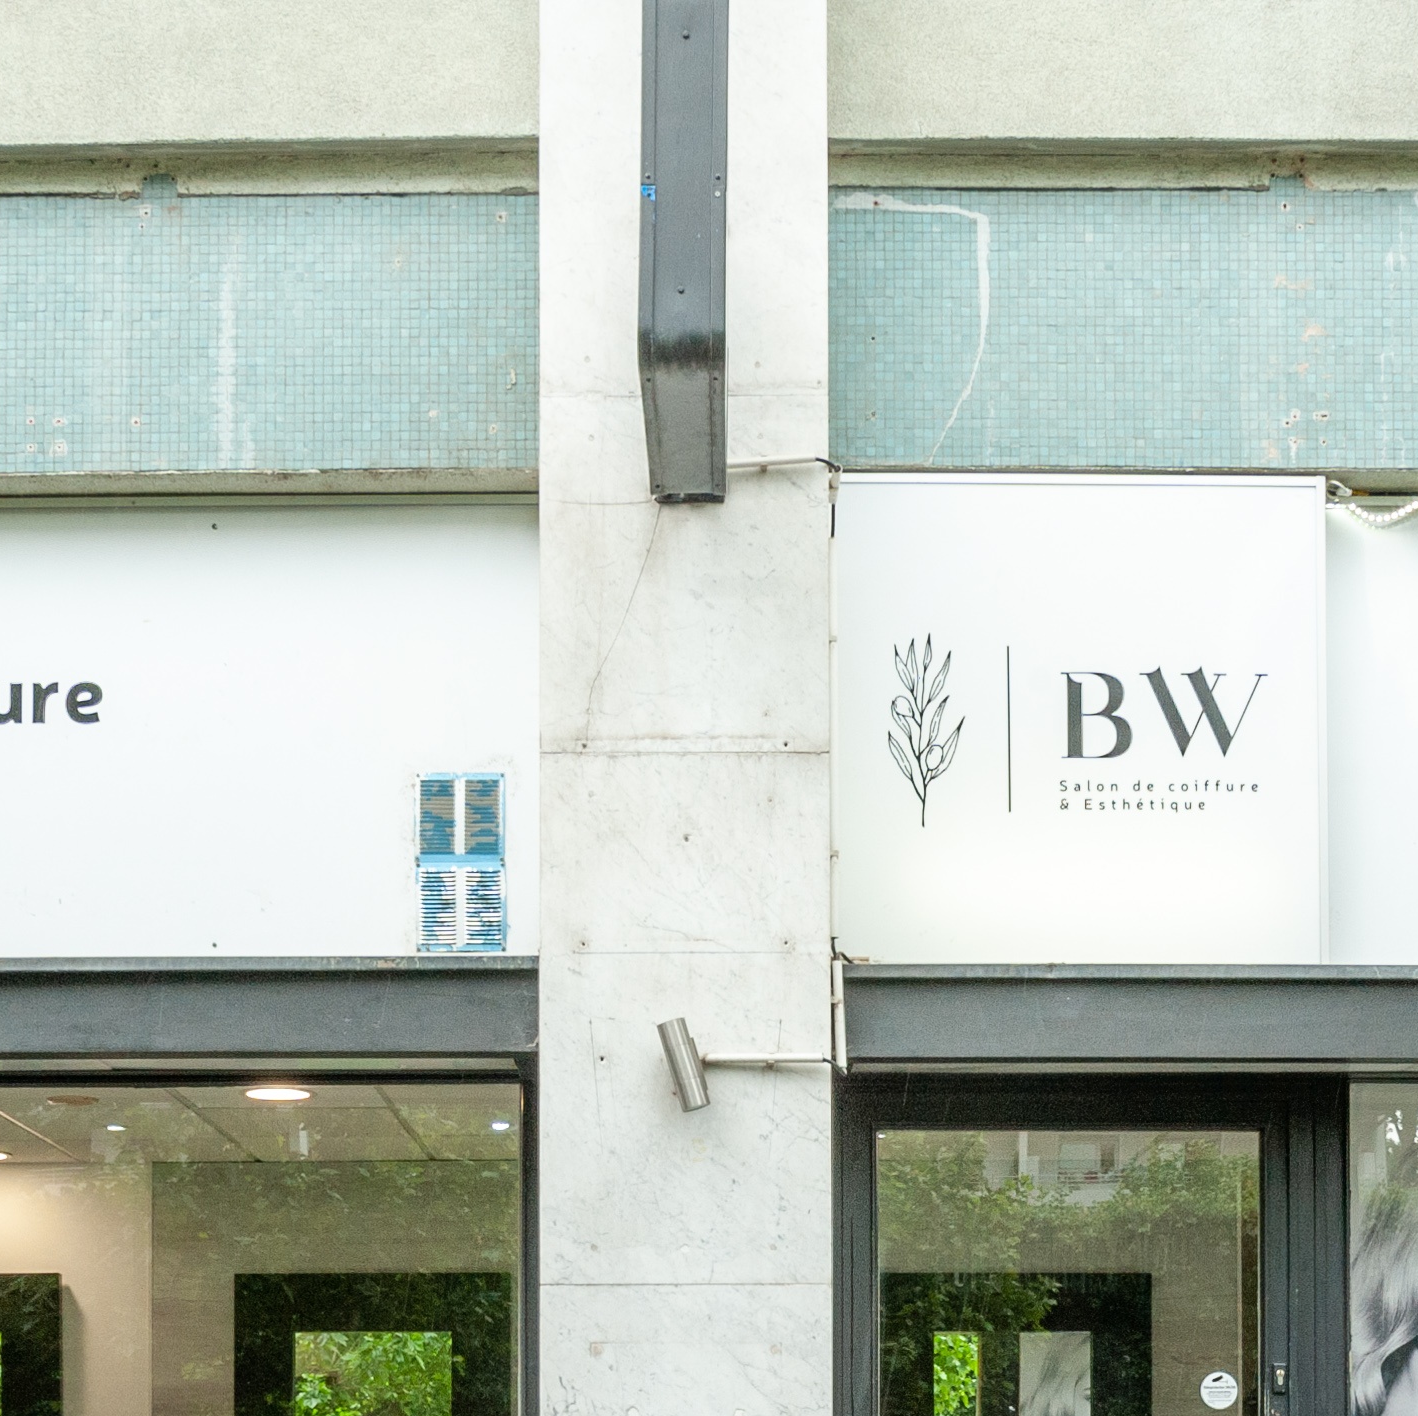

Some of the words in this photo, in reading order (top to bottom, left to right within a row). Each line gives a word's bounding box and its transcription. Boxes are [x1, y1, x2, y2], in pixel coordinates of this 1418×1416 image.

[1060, 666, 1268, 759] BW
[1059, 779, 1119, 792] Salon
[1132, 780, 1154, 792] de
[1168, 780, 1259, 792] coiffure
[1059, 799, 1069, 811] &
[1084, 798, 1206, 813] Esthétique
